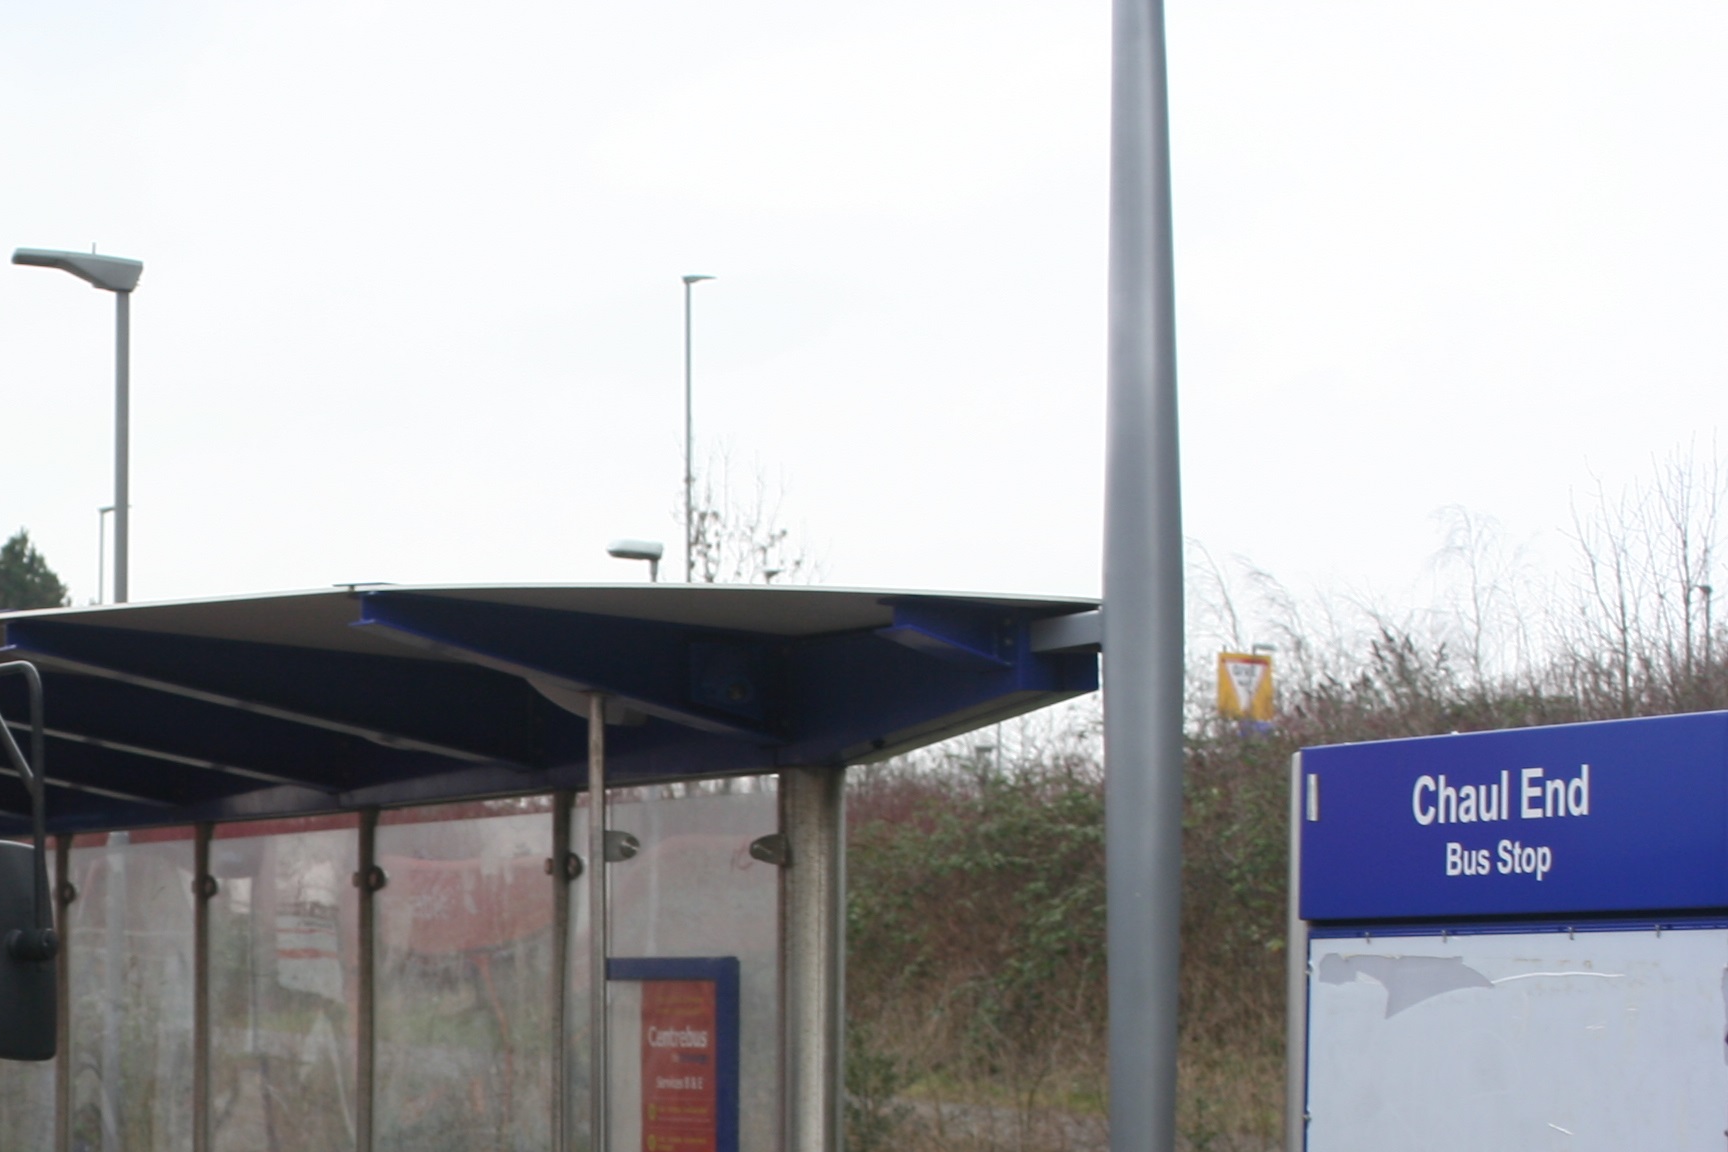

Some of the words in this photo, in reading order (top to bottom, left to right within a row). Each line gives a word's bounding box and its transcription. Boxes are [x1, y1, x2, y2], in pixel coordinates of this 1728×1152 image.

[1411, 769, 1510, 826] Chaul
[1519, 763, 1590, 820] End
[1445, 841, 1491, 877] Bus
[1497, 838, 1552, 882] Stop
